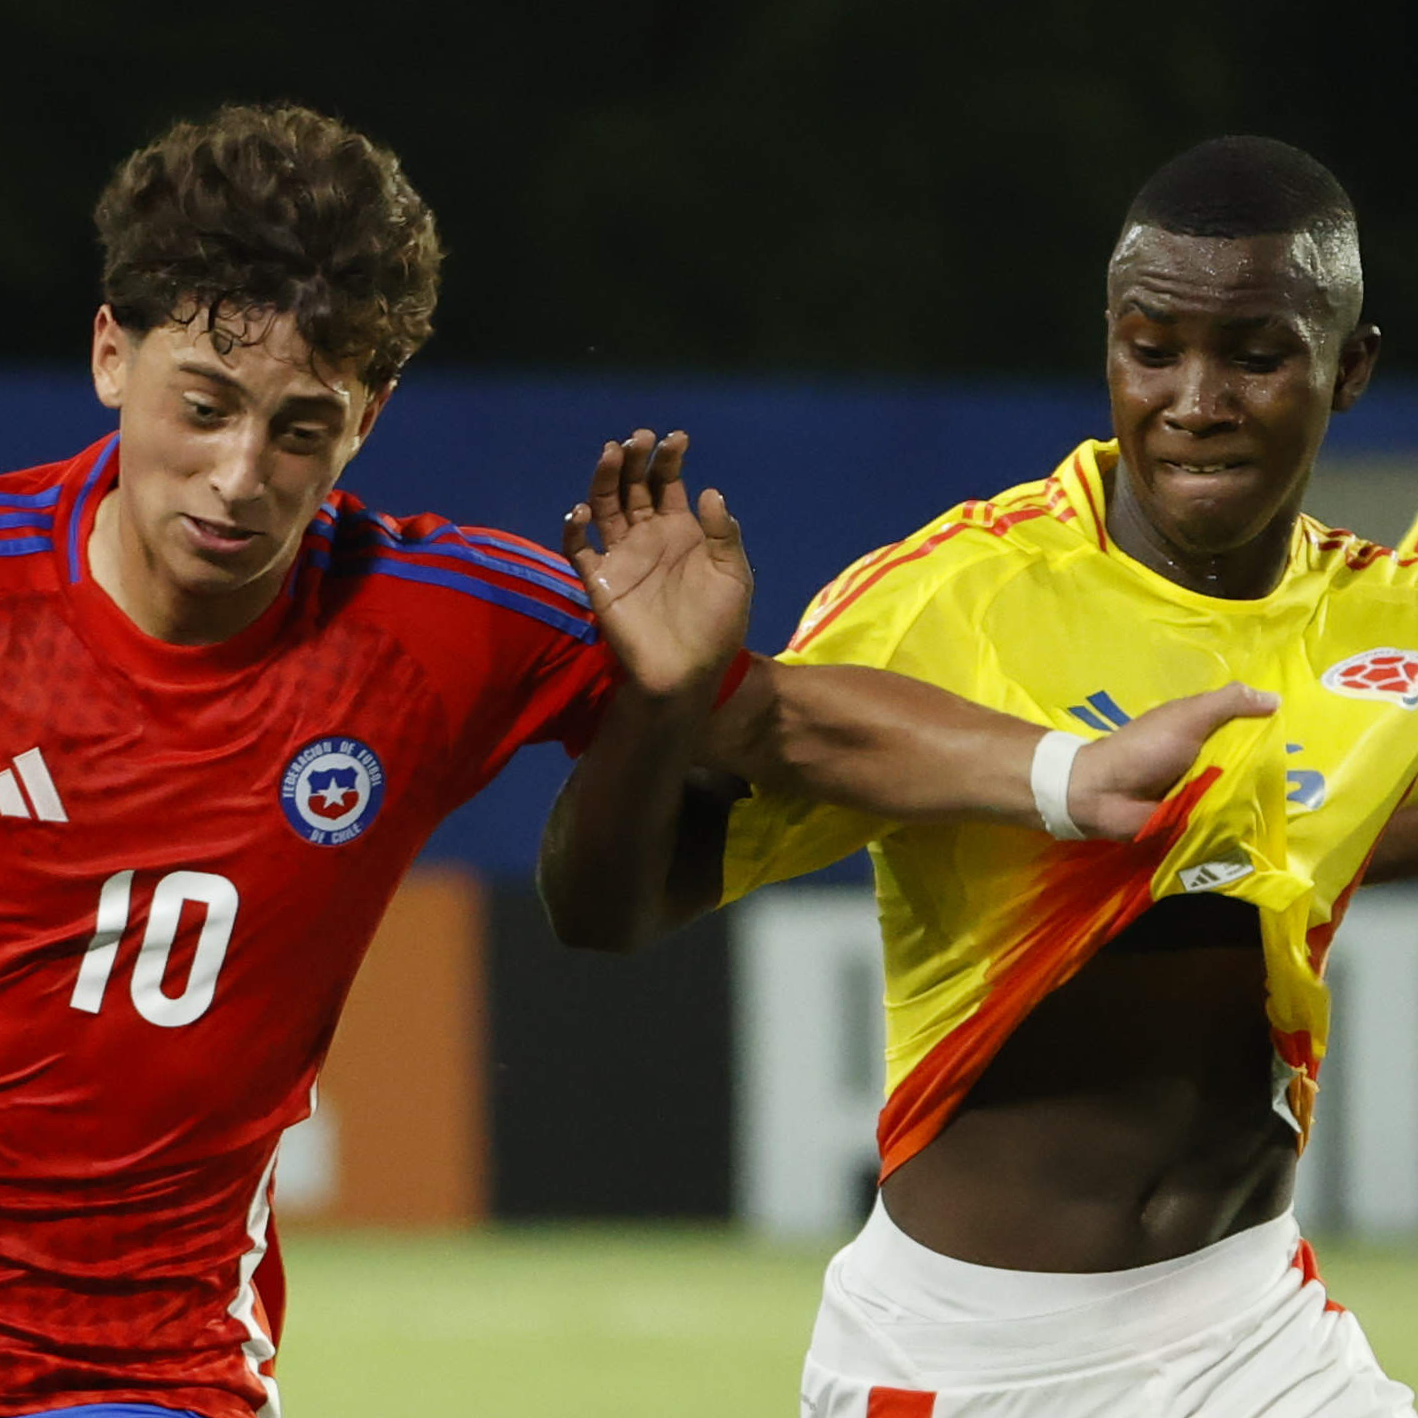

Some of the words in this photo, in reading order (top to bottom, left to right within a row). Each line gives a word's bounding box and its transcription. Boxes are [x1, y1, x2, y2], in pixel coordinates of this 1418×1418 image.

[340, 741, 356, 756] DE
[331, 822, 362, 844] CHILE
[69, 868, 239, 1027] 10
